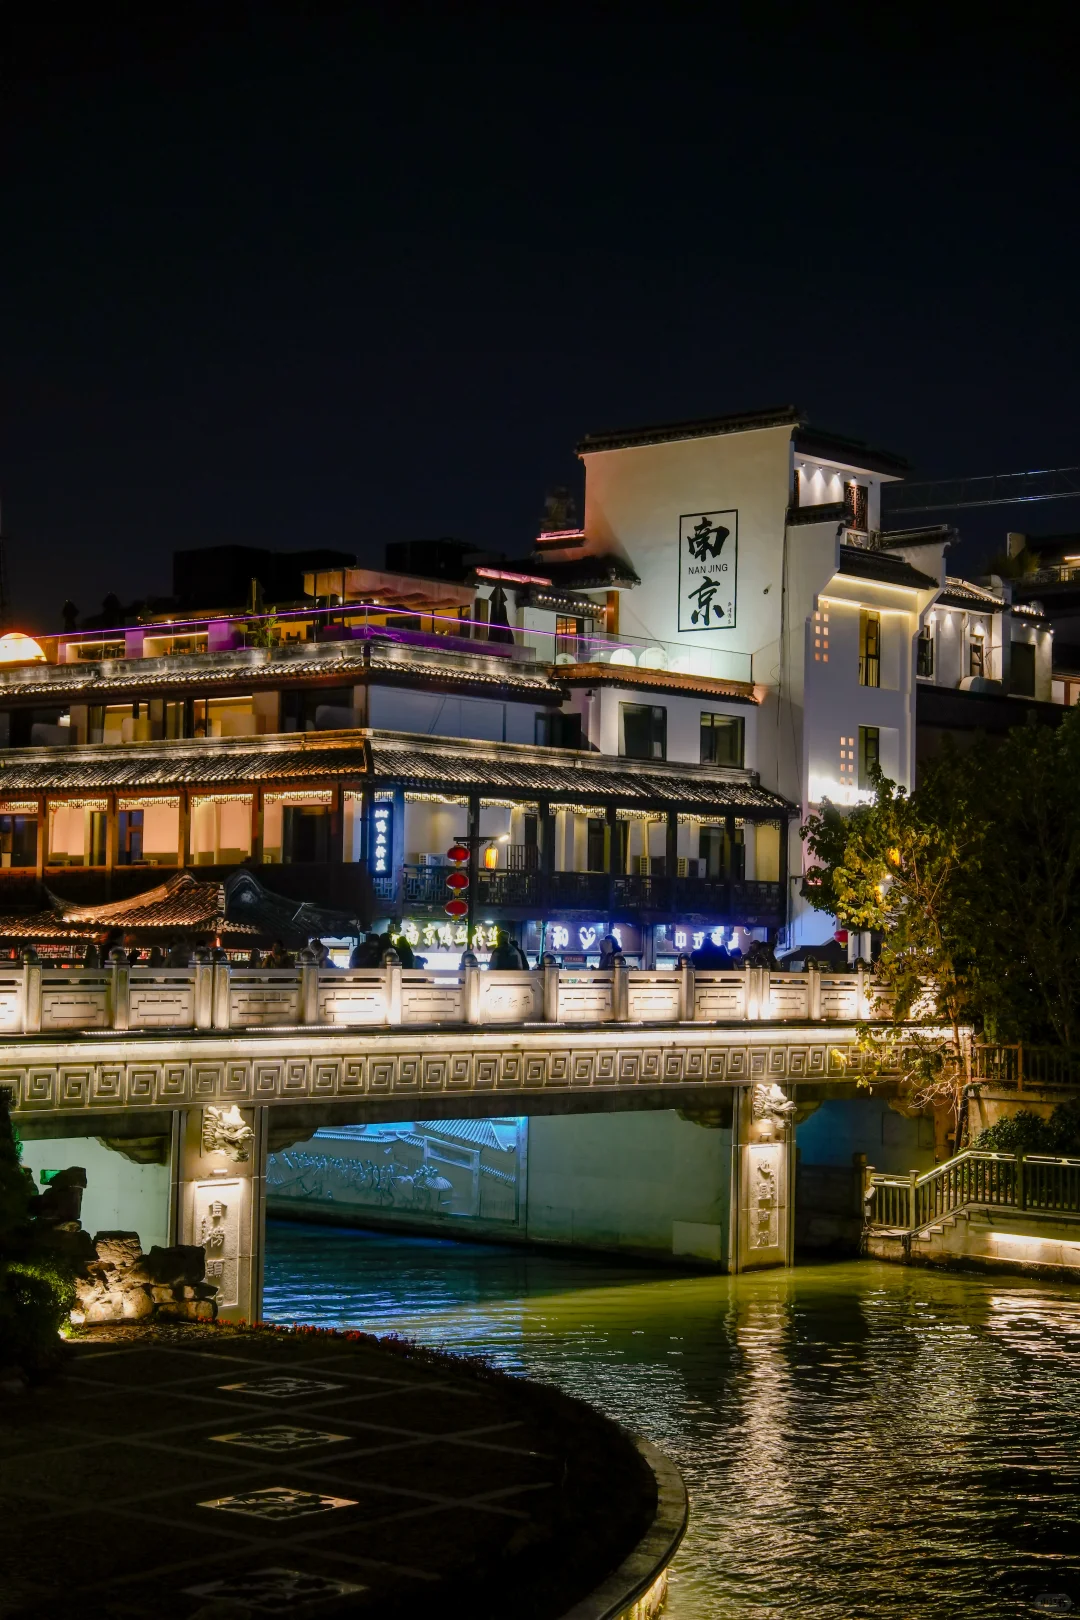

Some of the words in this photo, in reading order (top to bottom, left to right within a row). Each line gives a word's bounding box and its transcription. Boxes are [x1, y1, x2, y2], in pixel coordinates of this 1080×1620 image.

[687, 516, 730, 562] 南
[688, 566, 706, 575] NAN
[708, 563, 728, 574] JING
[688, 576, 724, 626] 京
